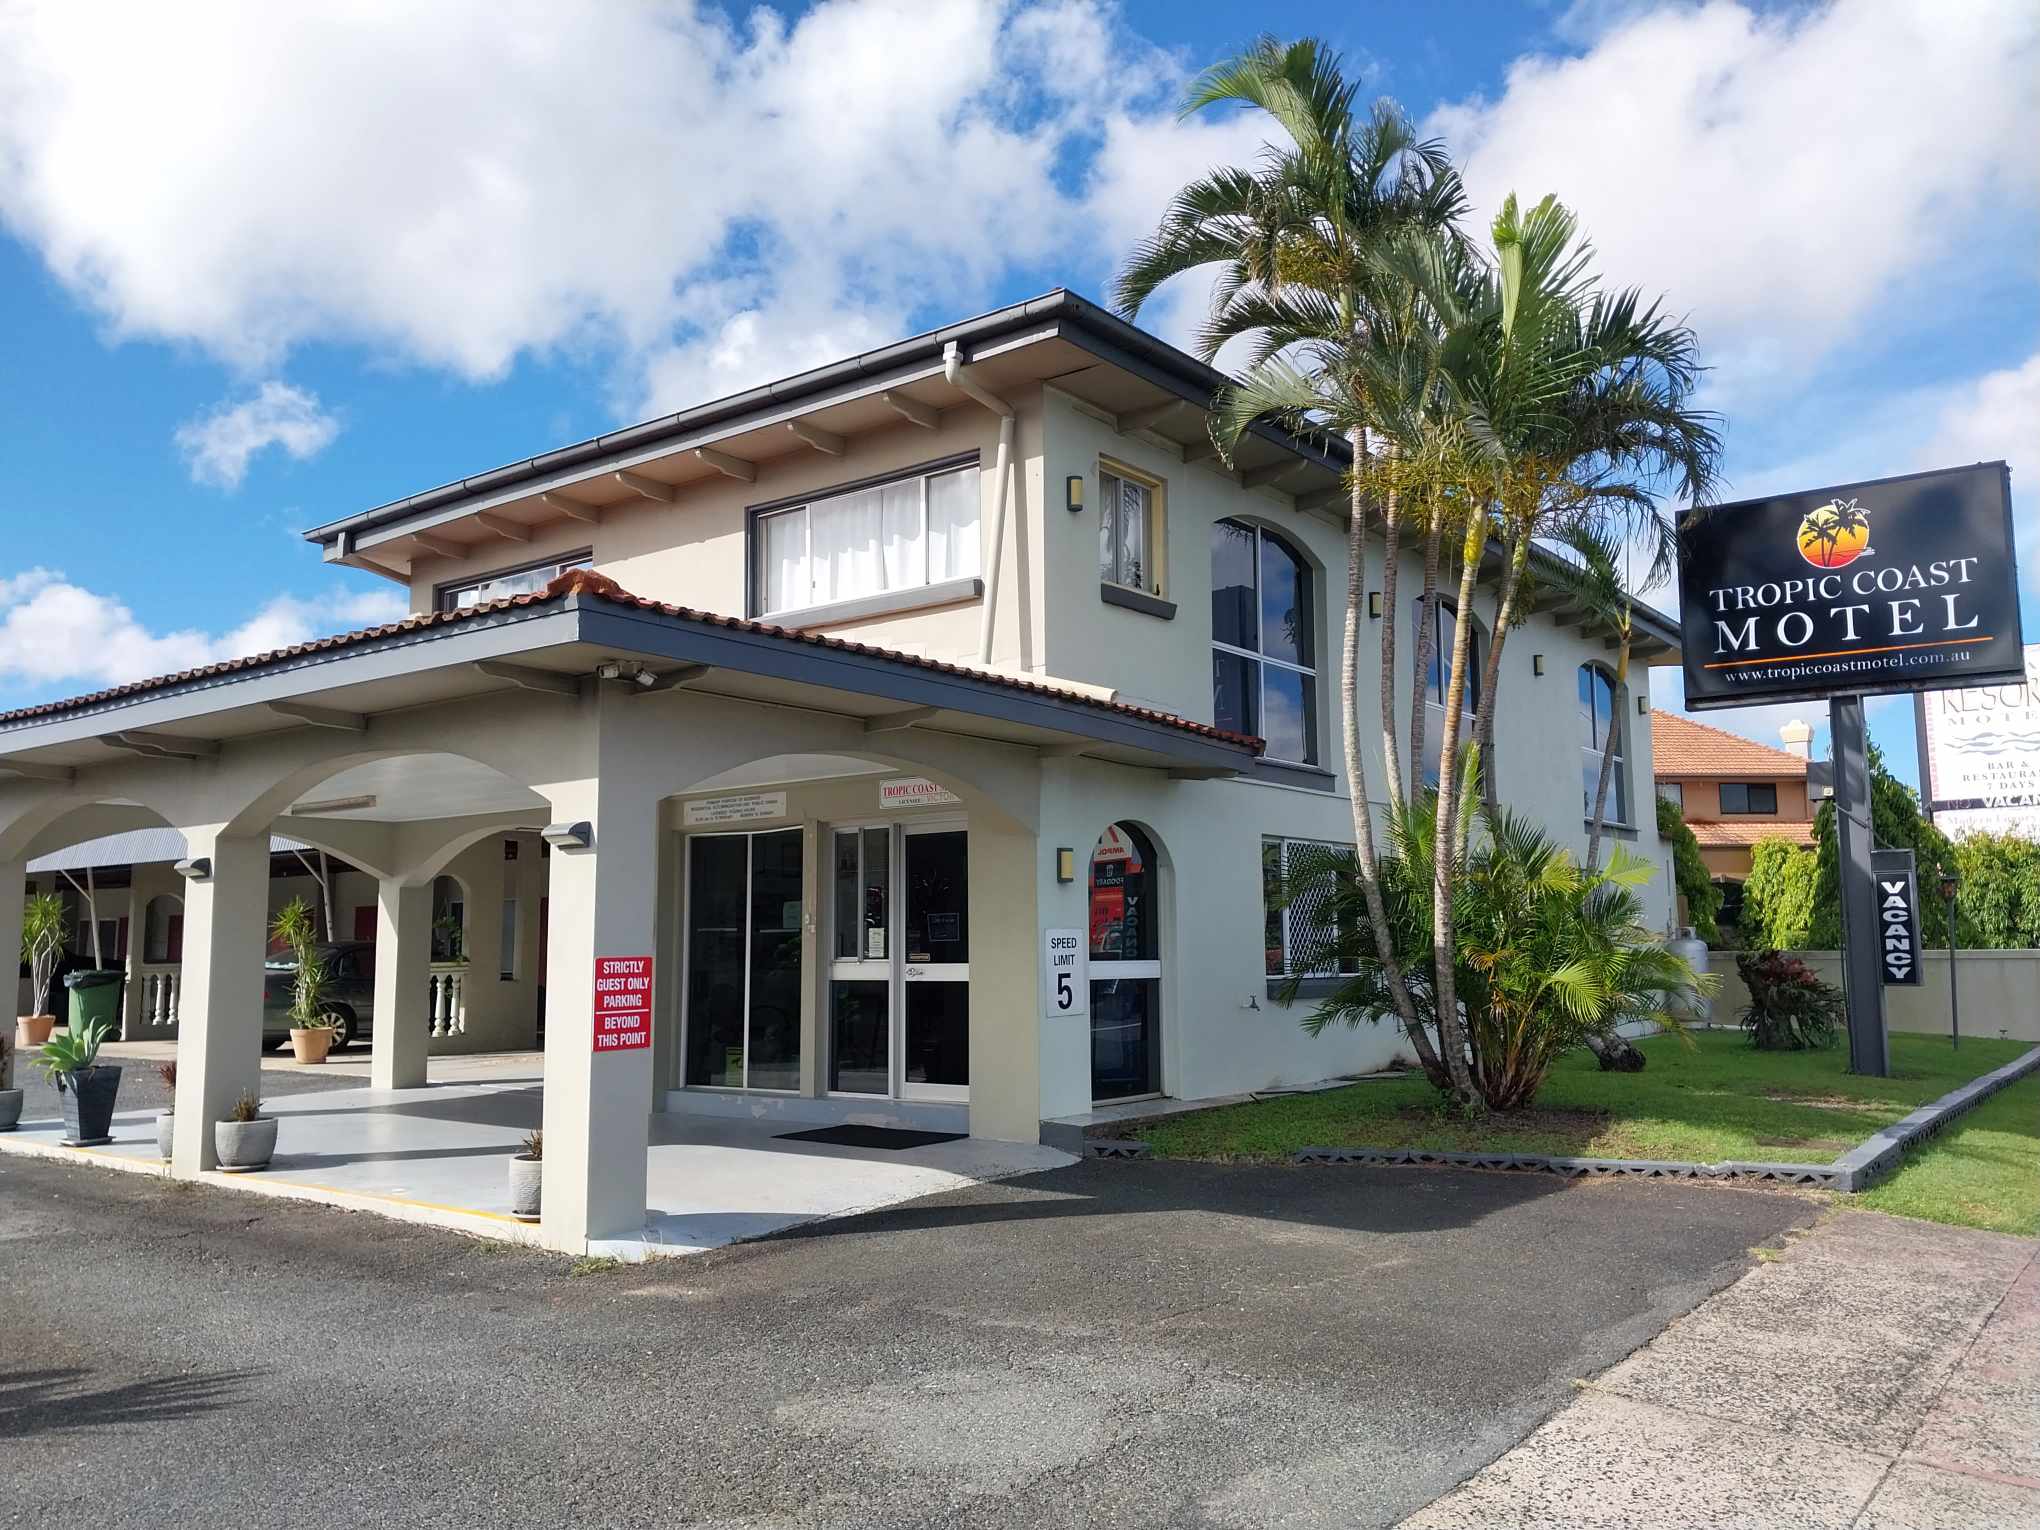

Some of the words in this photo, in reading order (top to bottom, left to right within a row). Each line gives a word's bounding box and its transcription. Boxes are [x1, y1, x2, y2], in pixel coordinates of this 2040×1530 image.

[1709, 575, 1842, 611] TROPIC
[1852, 557, 1979, 596] COAST
[1714, 594, 1979, 654] MOTEL
[1725, 651, 1970, 682] www.tropiccoastmotel.com.au
[882, 784, 912, 798] TROPIC
[911, 783, 939, 795] COAST
[1880, 881, 1912, 979] VACANCY
[1051, 937, 1077, 949] SPEED
[603, 960, 644, 974] STRICTLY
[1053, 954, 1075, 966] LIMIT
[596, 978, 626, 991] GUEST
[627, 977, 650, 990] ONLY
[1057, 972, 1073, 1010] 5
[603, 994, 642, 1008] PARKING
[604, 1015, 640, 1030] BEYOND
[597, 1033, 618, 1047] THIS
[620, 1031, 646, 1045] POINT
